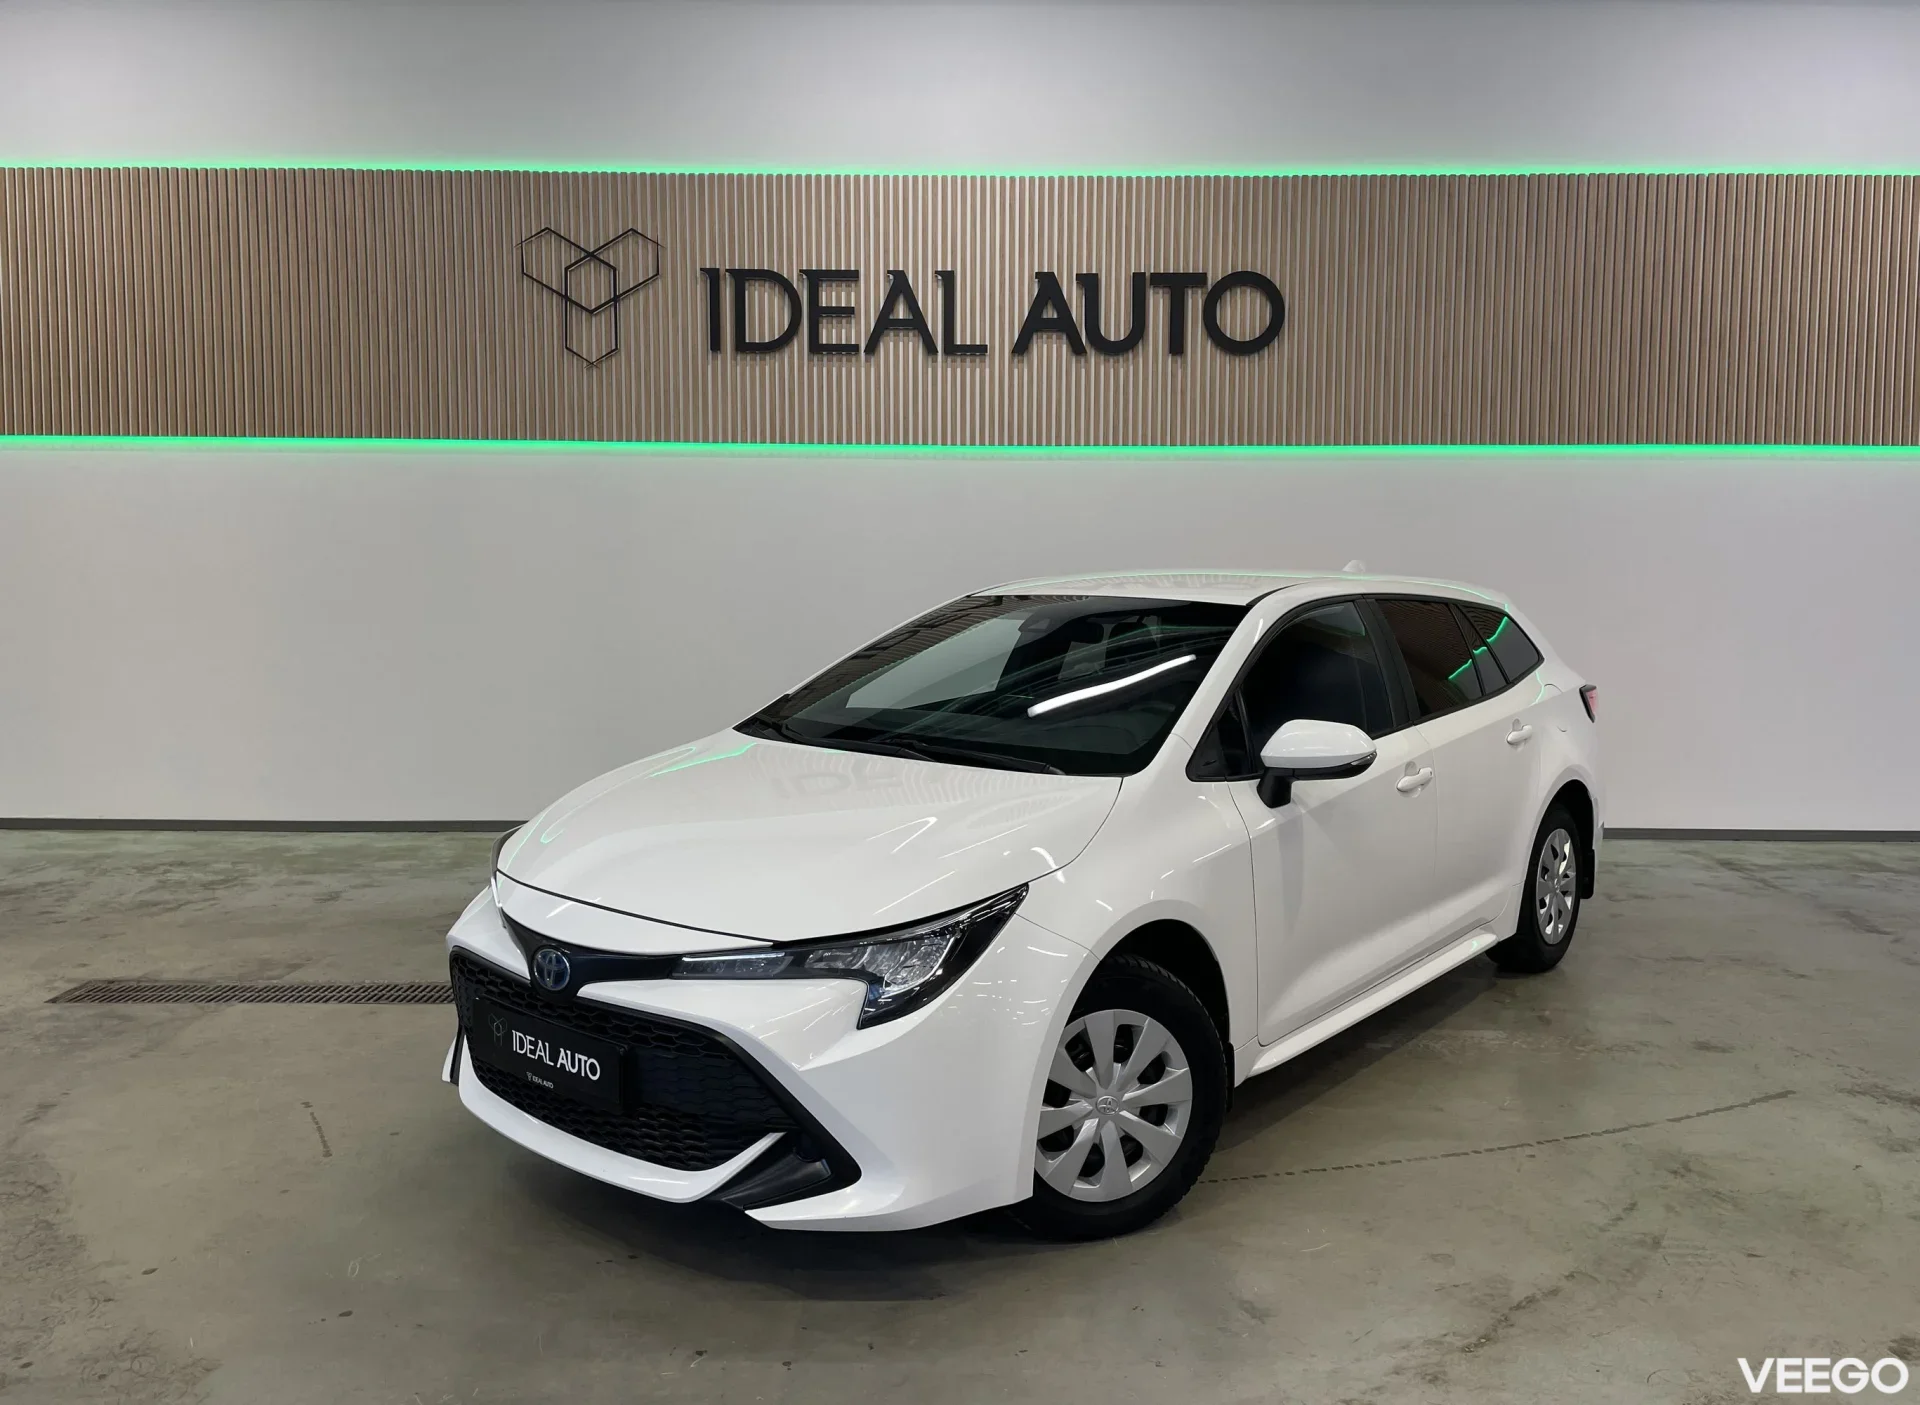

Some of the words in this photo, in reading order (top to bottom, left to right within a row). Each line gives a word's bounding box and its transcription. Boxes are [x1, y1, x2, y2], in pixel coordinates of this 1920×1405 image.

[699, 267, 988, 355] IDEAL
[1011, 270, 1285, 356] AUTO
[512, 1030, 554, 1066] IDEAL
[557, 1048, 600, 1080] AUTO
